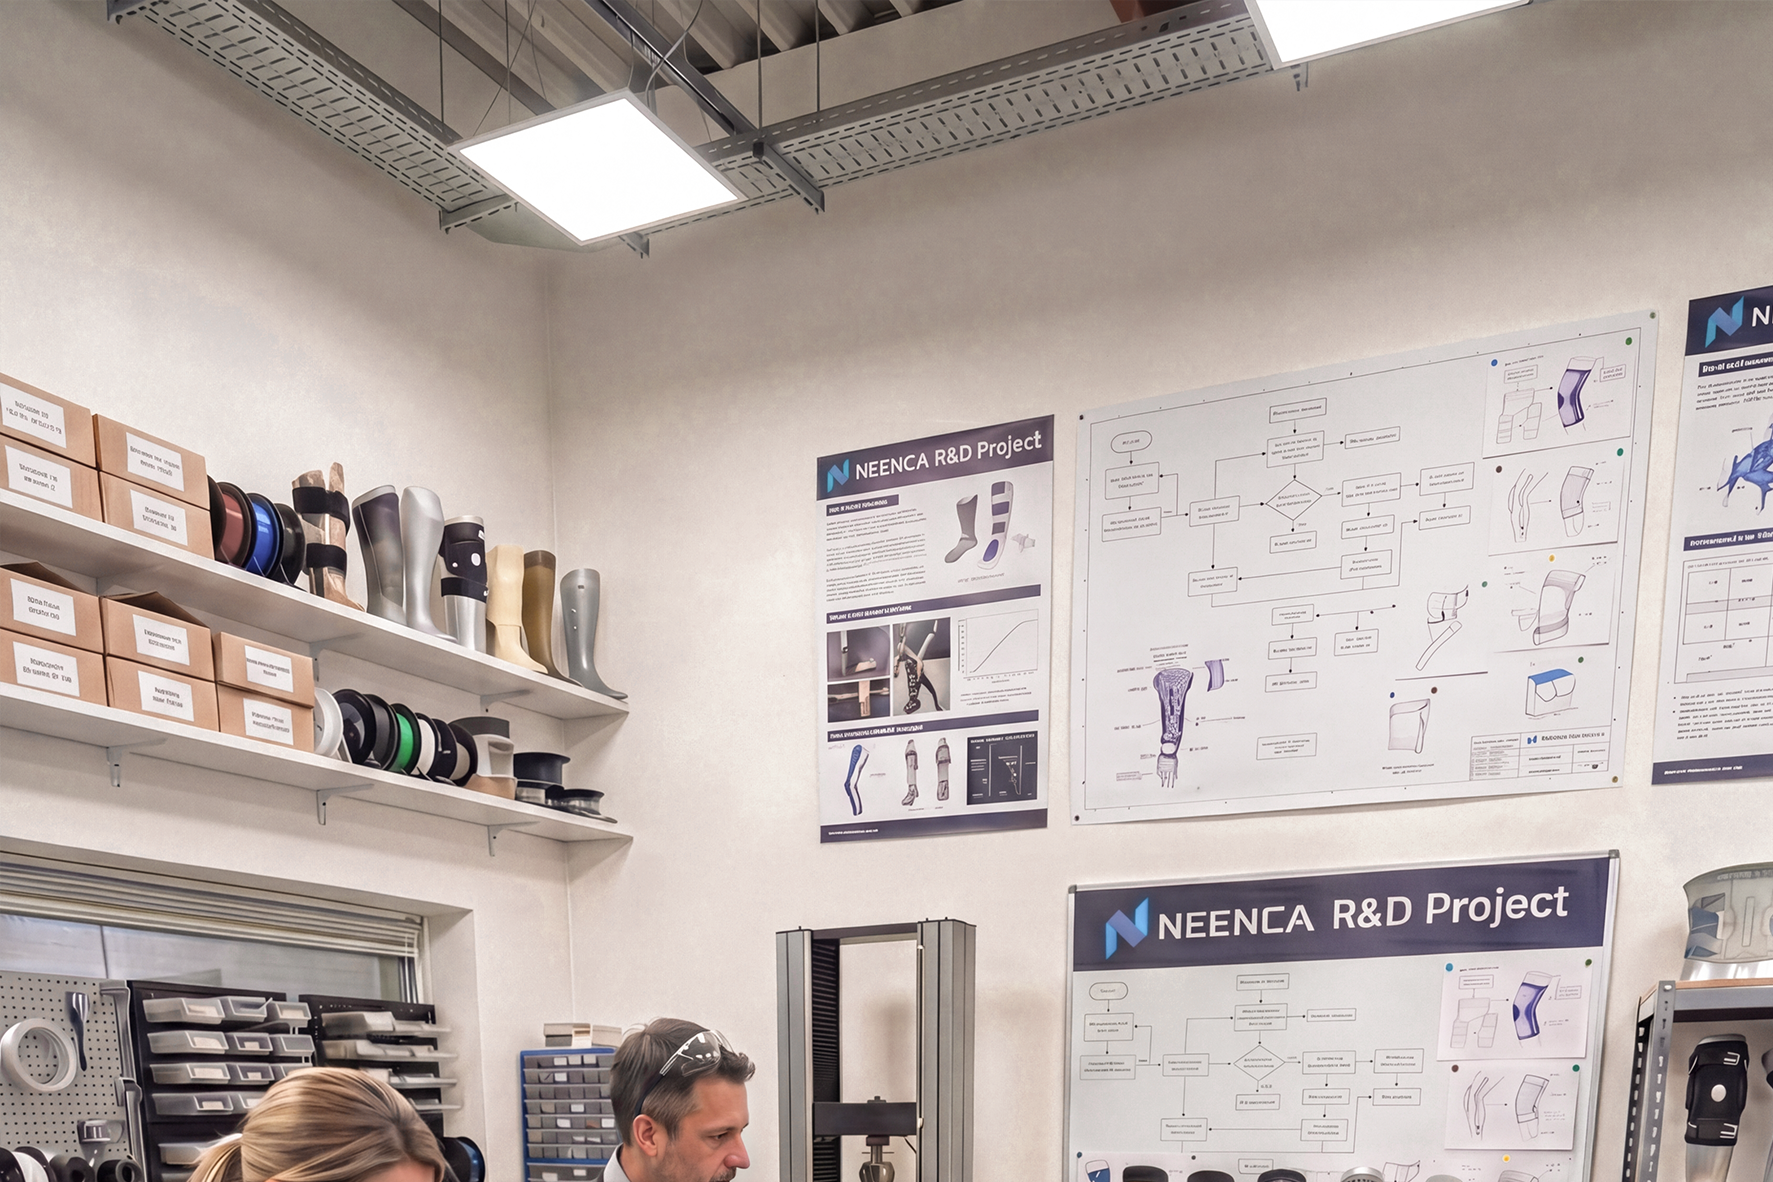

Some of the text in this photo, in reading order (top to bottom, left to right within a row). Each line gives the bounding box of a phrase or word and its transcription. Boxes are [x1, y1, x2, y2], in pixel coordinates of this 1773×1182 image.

[855, 430, 1043, 480] NEENCA R&D Project
[1158, 886, 1570, 940] NEENCA R&D Project
